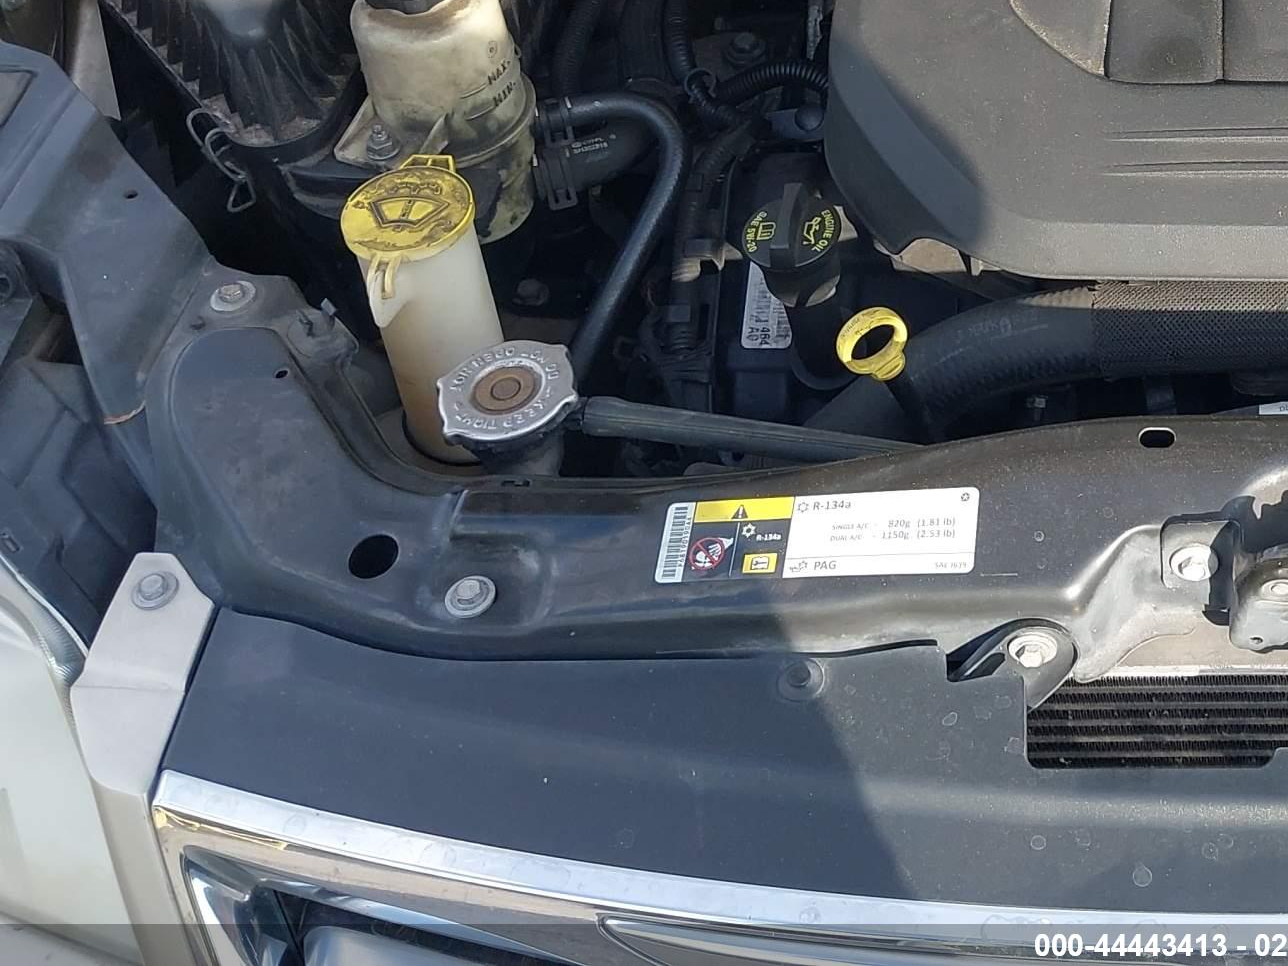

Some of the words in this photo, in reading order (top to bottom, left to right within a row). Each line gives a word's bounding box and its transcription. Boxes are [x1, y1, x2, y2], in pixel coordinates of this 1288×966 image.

[750, 211, 767, 227] SAE
[820, 209, 835, 239] ENGINE
[811, 239, 829, 253] OIL
[813, 500, 852, 511] R-134a
[888, 519, 911, 529] 820g
[917, 518, 940, 528] (1.81
[943, 517, 956, 527] lb)
[756, 533, 782, 542] R-134a
[881, 530, 910, 540] 1150g
[917, 529, 941, 539] (2.53
[943, 528, 956, 538] lb)
[813, 560, 838, 571] PAG
